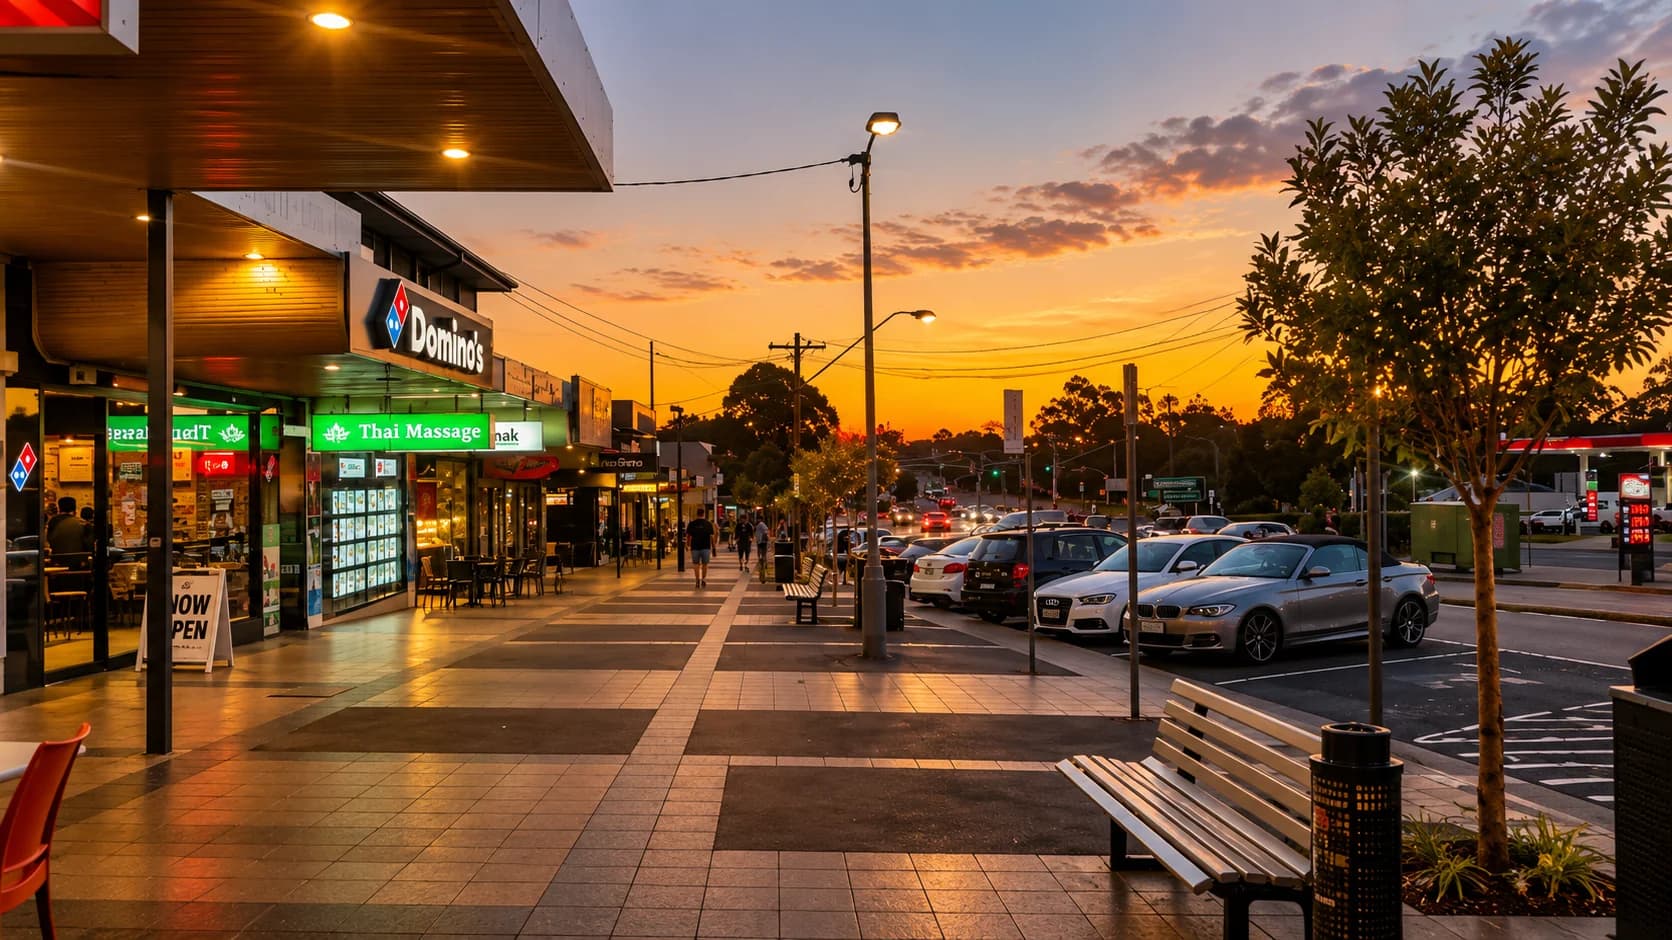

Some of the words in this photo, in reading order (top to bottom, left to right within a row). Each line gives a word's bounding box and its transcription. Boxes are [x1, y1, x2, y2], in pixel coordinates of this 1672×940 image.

[411, 305, 483, 374] Domino's
[358, 422, 399, 439] Thai
[405, 423, 481, 442] Massage
[172, 620, 208, 640] PEN
